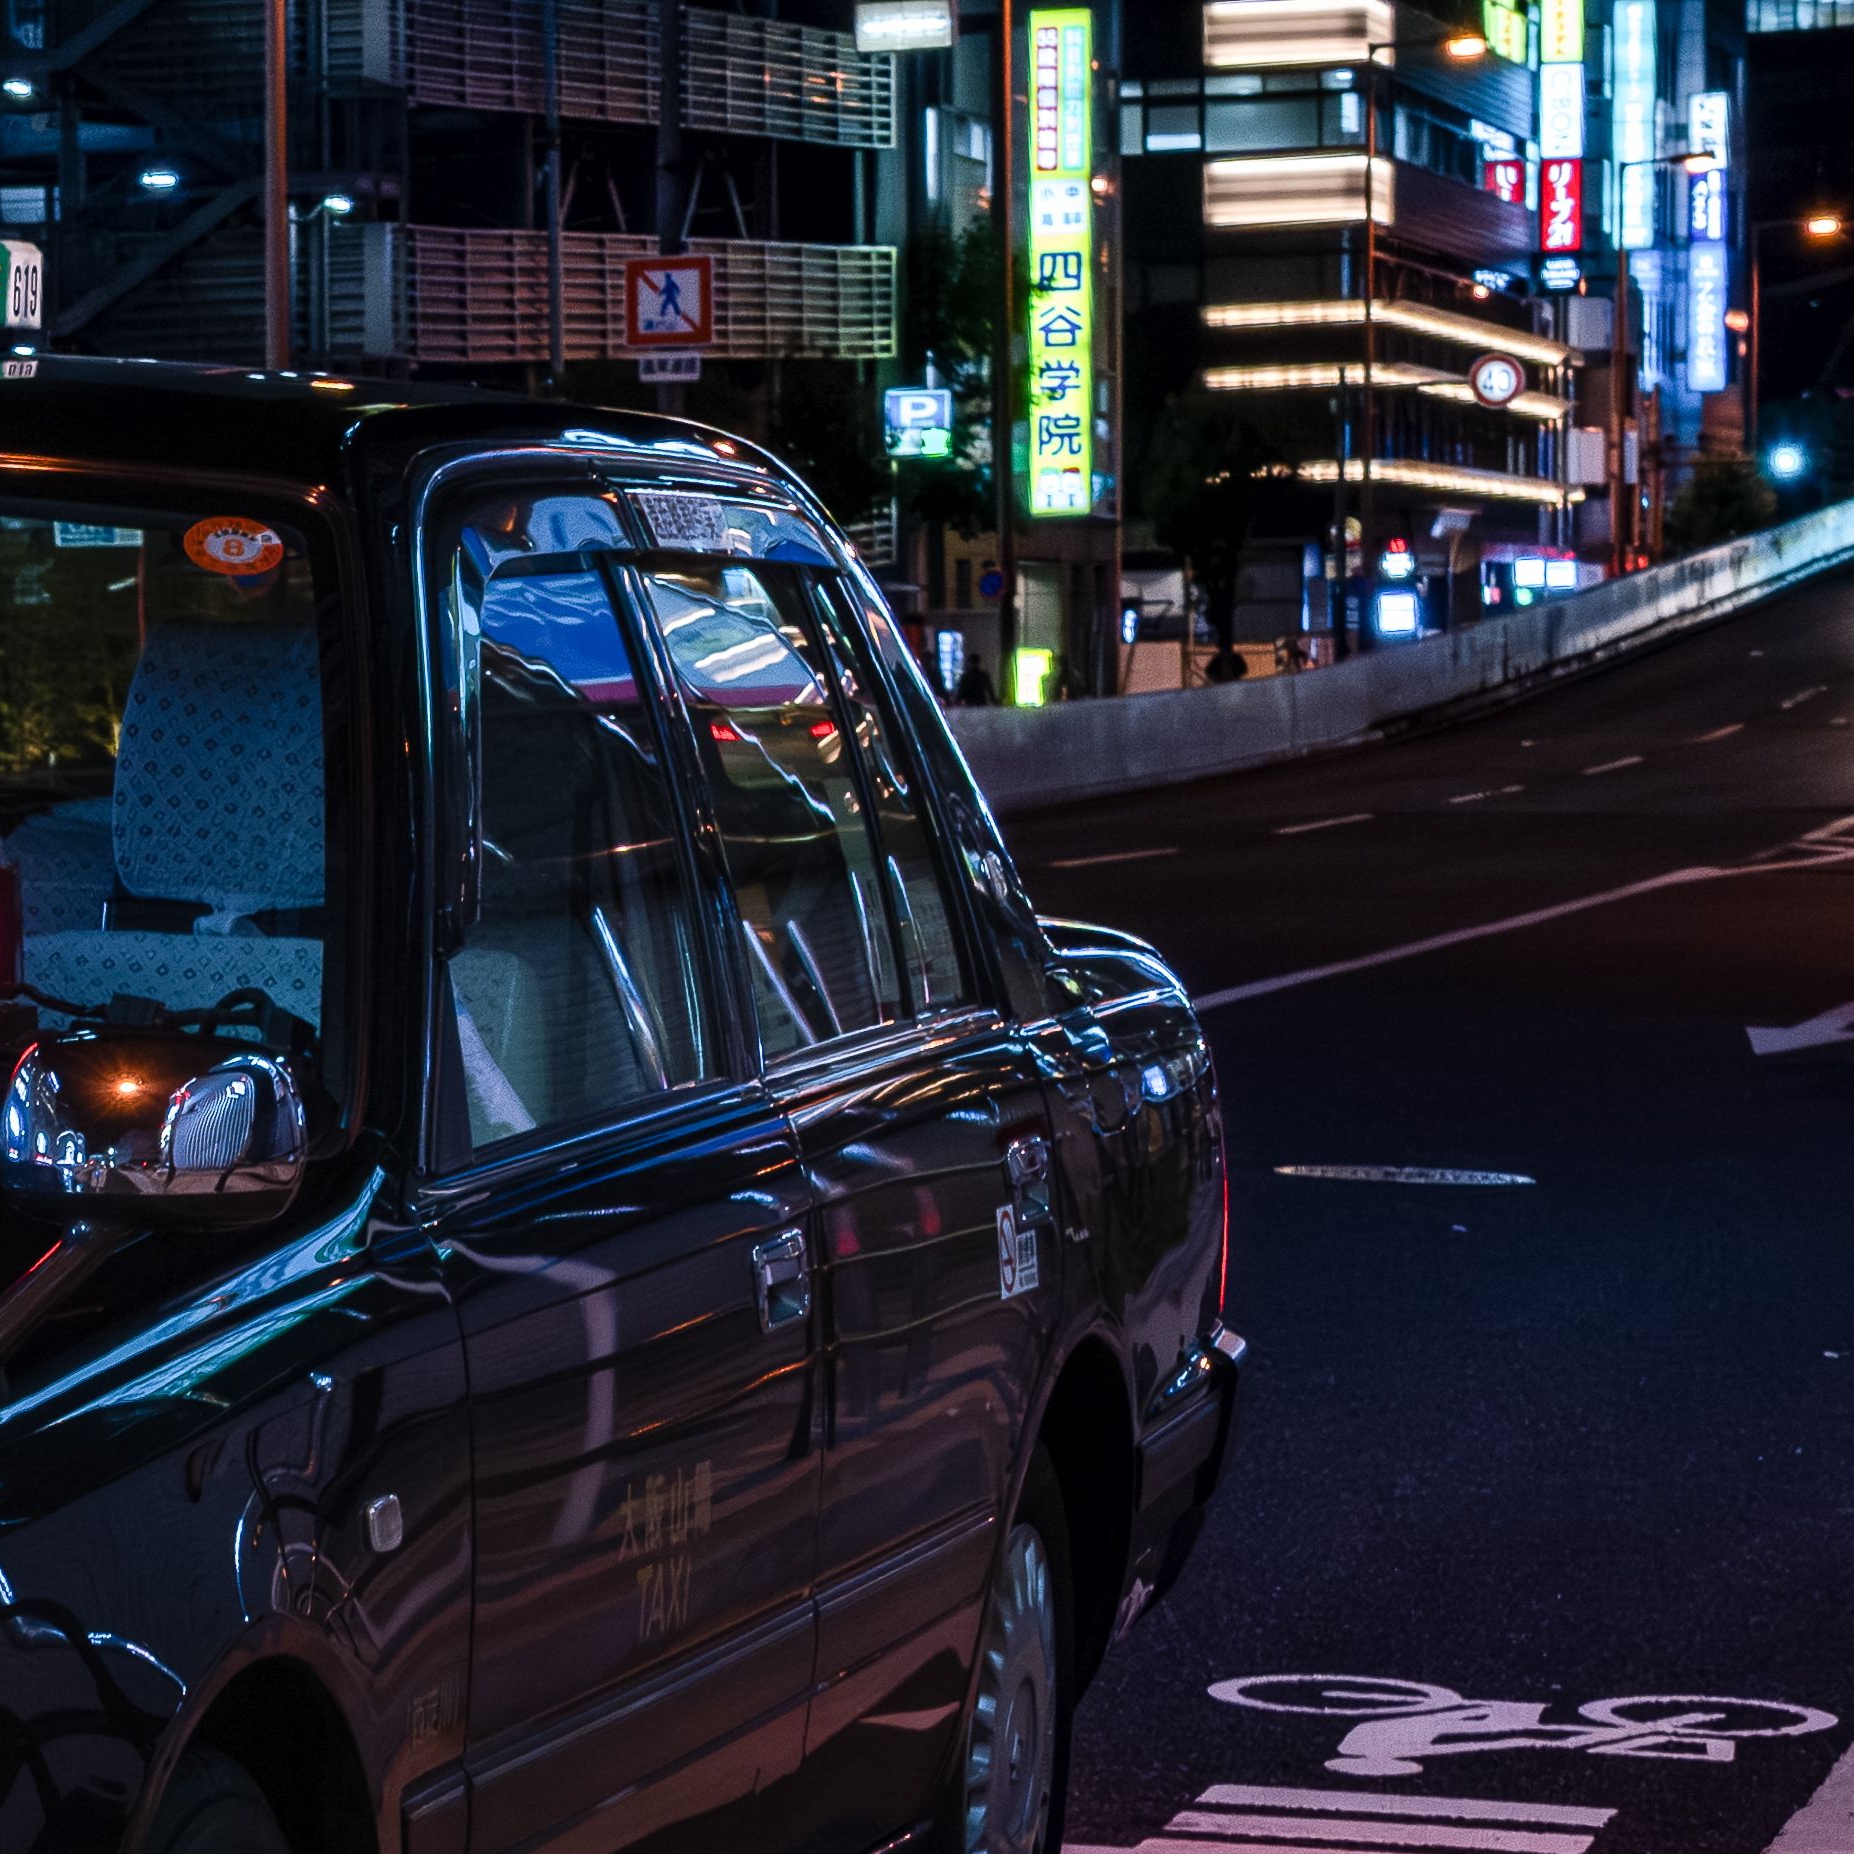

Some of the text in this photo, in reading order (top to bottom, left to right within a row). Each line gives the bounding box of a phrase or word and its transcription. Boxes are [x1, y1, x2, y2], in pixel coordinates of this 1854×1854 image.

[1547, 162, 1573, 249] リーブ21
[12, 264, 38, 318] 619
[1038, 251, 1082, 456] 四谷学院
[1482, 367, 1511, 392] 40
[900, 395, 939, 427] P
[636, 1552, 692, 1644] TAXI
